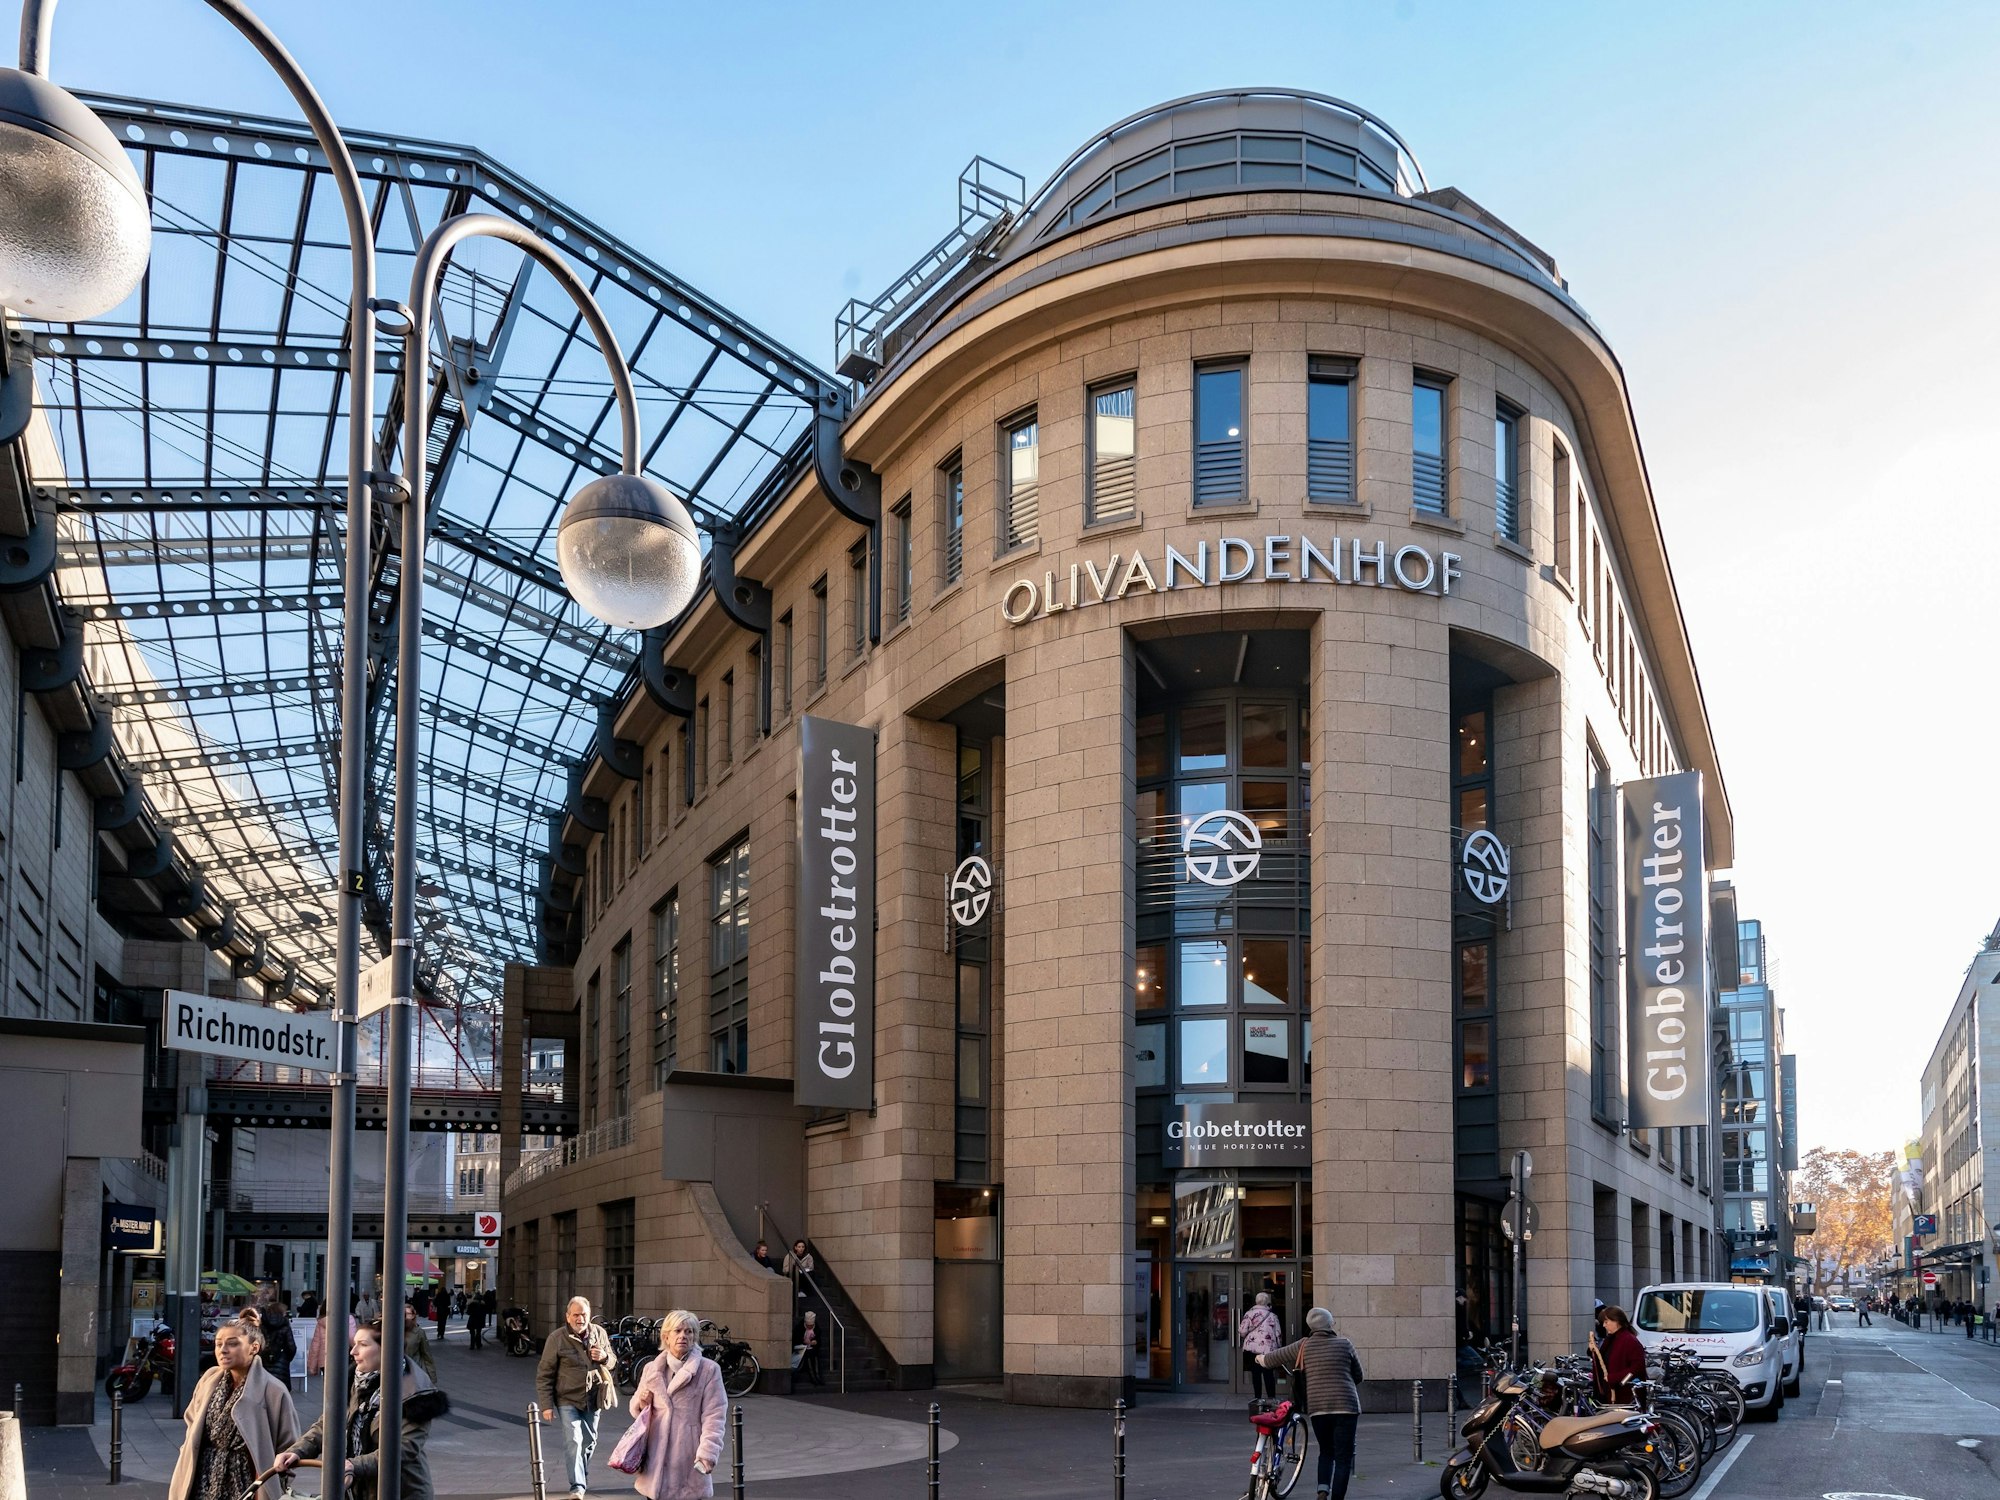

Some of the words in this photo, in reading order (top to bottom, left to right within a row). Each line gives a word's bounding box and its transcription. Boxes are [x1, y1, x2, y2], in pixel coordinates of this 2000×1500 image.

[1002, 536, 1462, 625] OLIVANDENHOF
[355, 874, 364, 891] 2
[818, 748, 858, 1080] Globetrotter
[1643, 801, 1687, 1102] Globetrotter
[177, 1003, 330, 1061] Richmodstr.
[1166, 1120, 1306, 1139] Globetrotter
[1783, 1077, 1796, 1146] PRIMARK
[1189, 1143, 1217, 1151] NEUE
[1223, 1143, 1286, 1151] HORIZONTE
